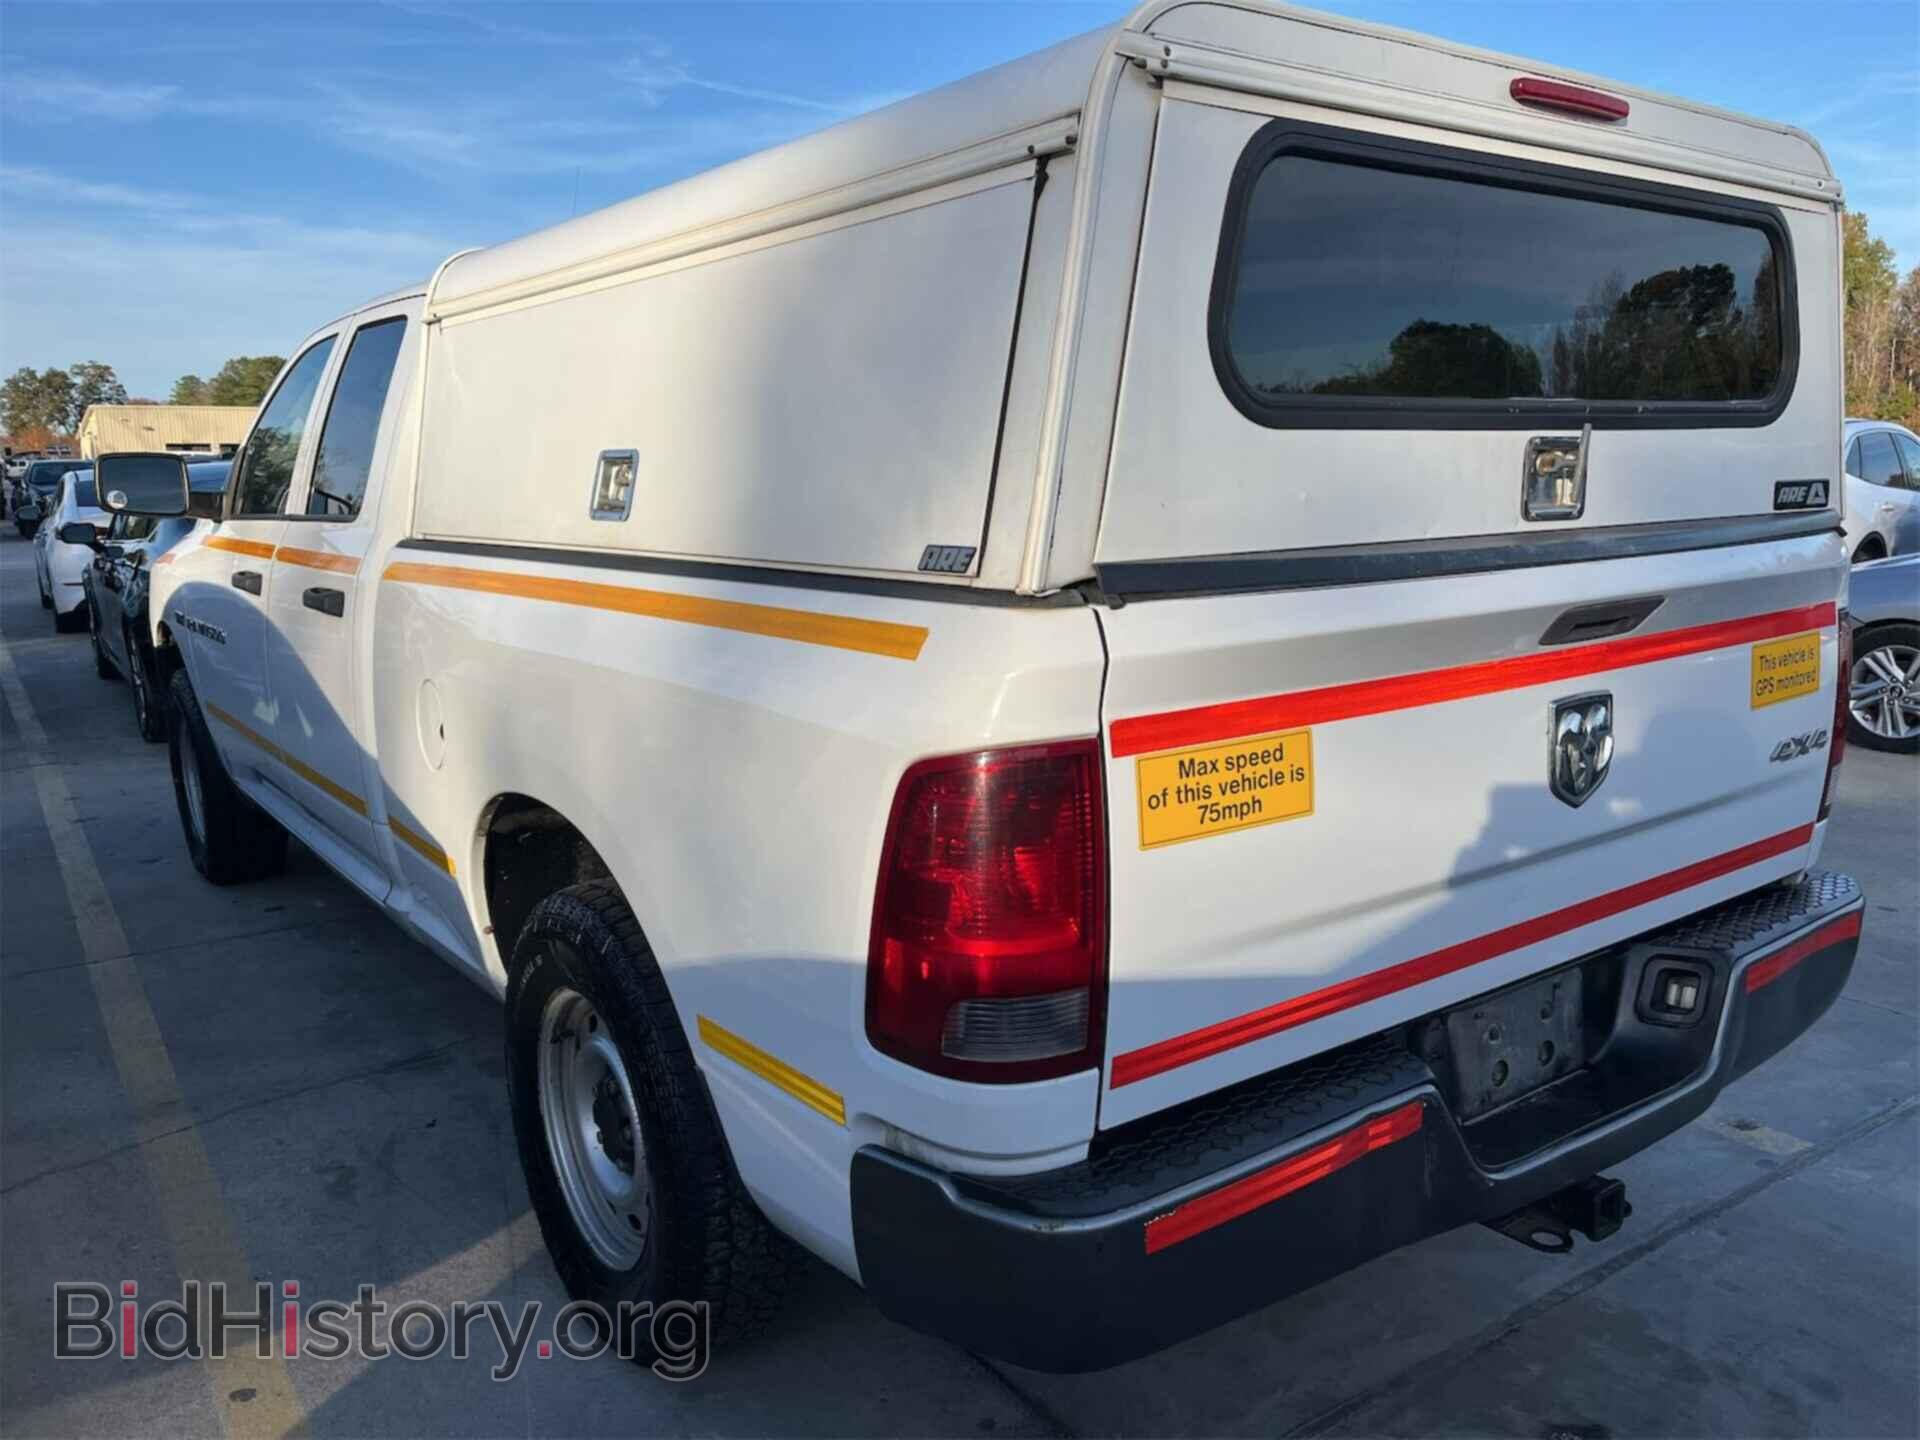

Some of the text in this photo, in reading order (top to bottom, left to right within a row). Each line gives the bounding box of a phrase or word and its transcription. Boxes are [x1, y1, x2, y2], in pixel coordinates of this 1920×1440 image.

[1777, 486, 1807, 504] ARE
[1760, 646, 1815, 672] This vehicle is
[1756, 669, 1816, 696] GPS monitored
[1178, 743, 1284, 779] Max speed
[1148, 764, 1305, 810] of this vehicle is
[1197, 796, 1262, 825] 75mph
